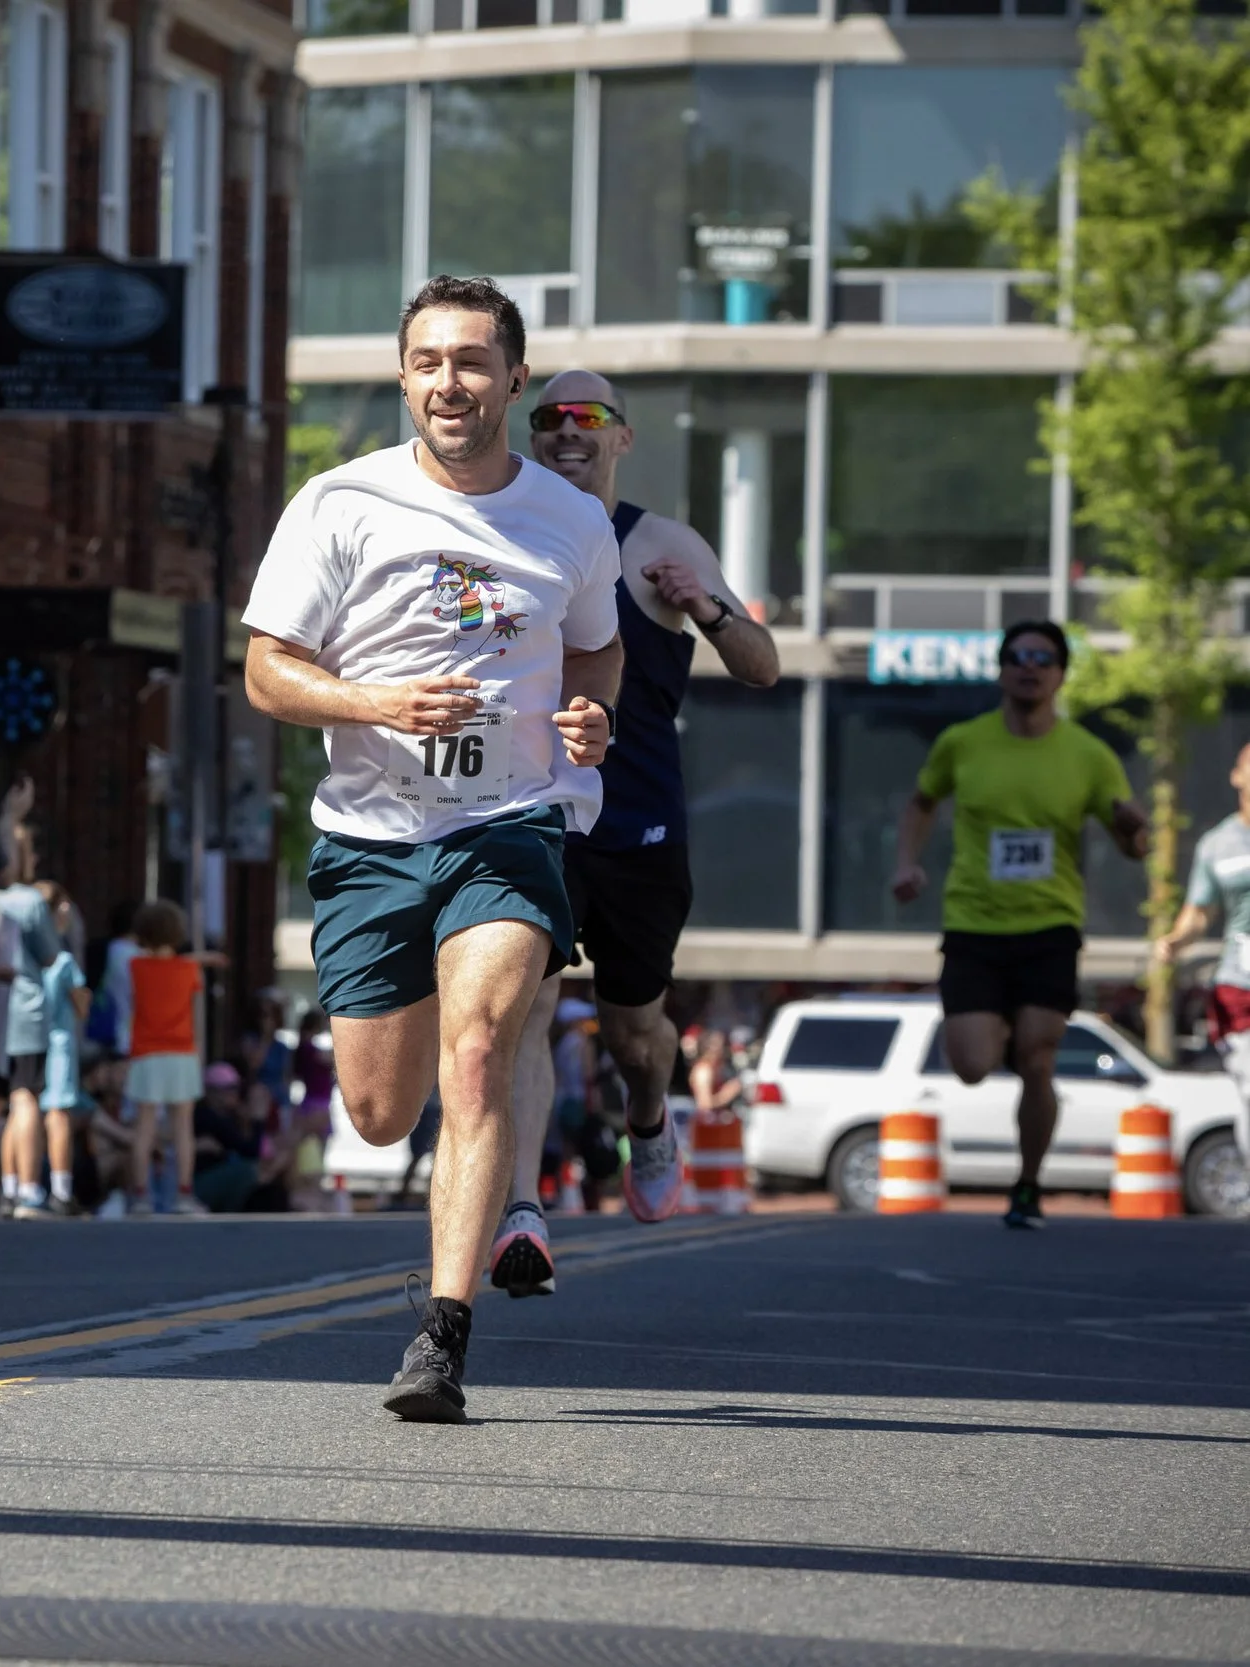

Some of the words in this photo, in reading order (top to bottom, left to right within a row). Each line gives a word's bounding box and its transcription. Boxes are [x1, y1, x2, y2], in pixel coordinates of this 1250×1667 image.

[490, 694, 507, 704] Club
[418, 735, 484, 777] 176
[396, 792, 420, 801] FOOD
[437, 796, 463, 804] DRINK
[477, 794, 501, 803] DRINK
